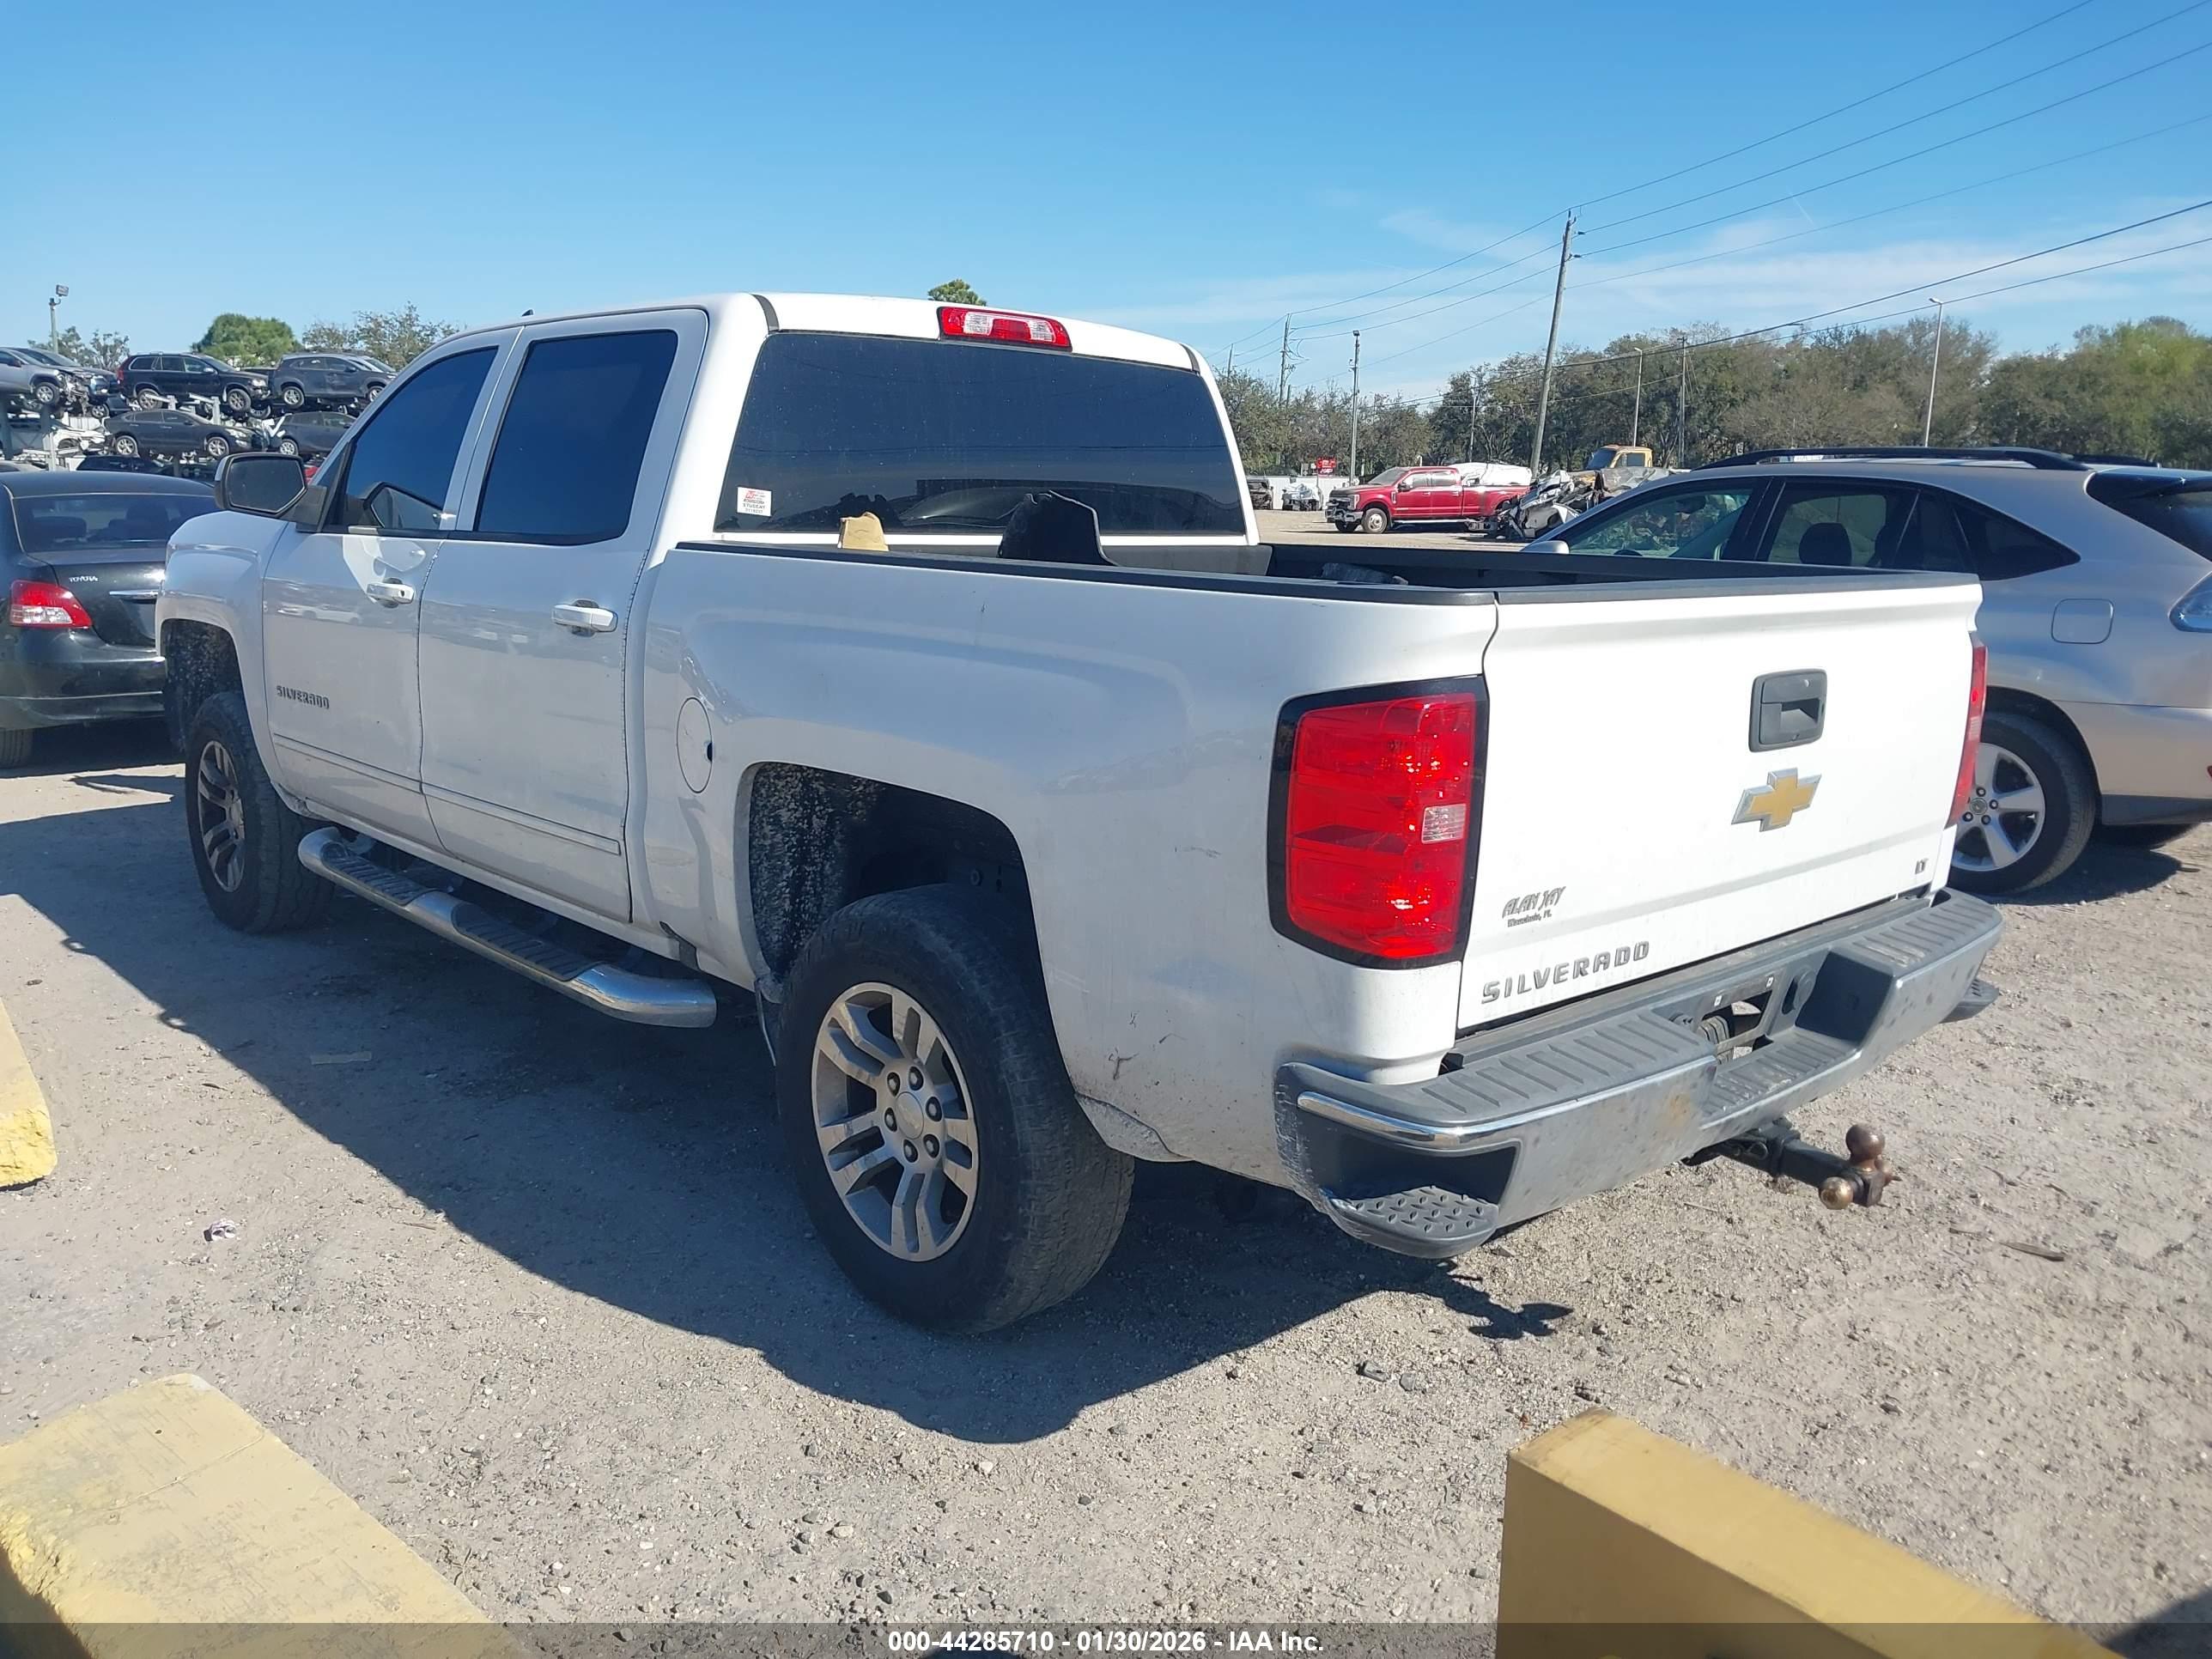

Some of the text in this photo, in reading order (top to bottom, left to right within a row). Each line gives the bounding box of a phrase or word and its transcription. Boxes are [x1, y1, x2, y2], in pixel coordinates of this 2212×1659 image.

[276, 685, 330, 709] SILVERADO
[1502, 886, 1566, 919] ALAN JAY
[1481, 941, 1650, 1004] SILVERADO
